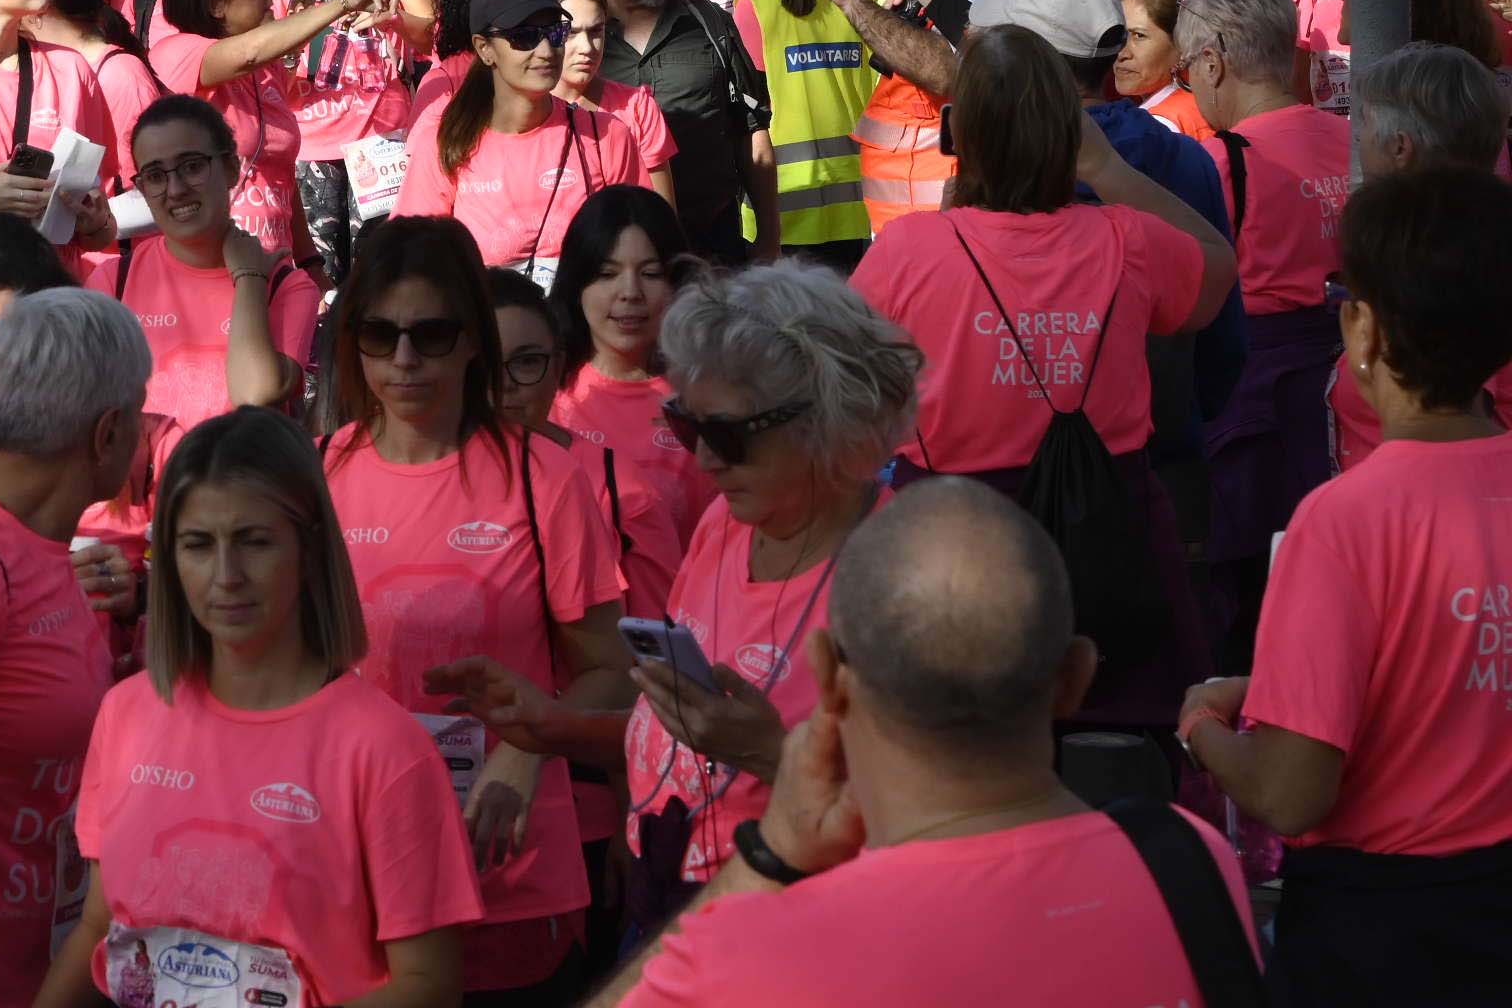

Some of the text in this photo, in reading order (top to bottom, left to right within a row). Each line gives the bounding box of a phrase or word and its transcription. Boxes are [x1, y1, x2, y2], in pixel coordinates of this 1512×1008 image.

[379, 161, 407, 176] 016
[973, 310, 1103, 337] CARRERA
[999, 335, 1080, 361] DE LA
[991, 360, 1084, 386] MUJER
[130, 763, 195, 790] OYSHO
[256, 792, 314, 819] ASTURIANA
[162, 955, 232, 981] ASTURIANA
[248, 962, 288, 981] SUMA
